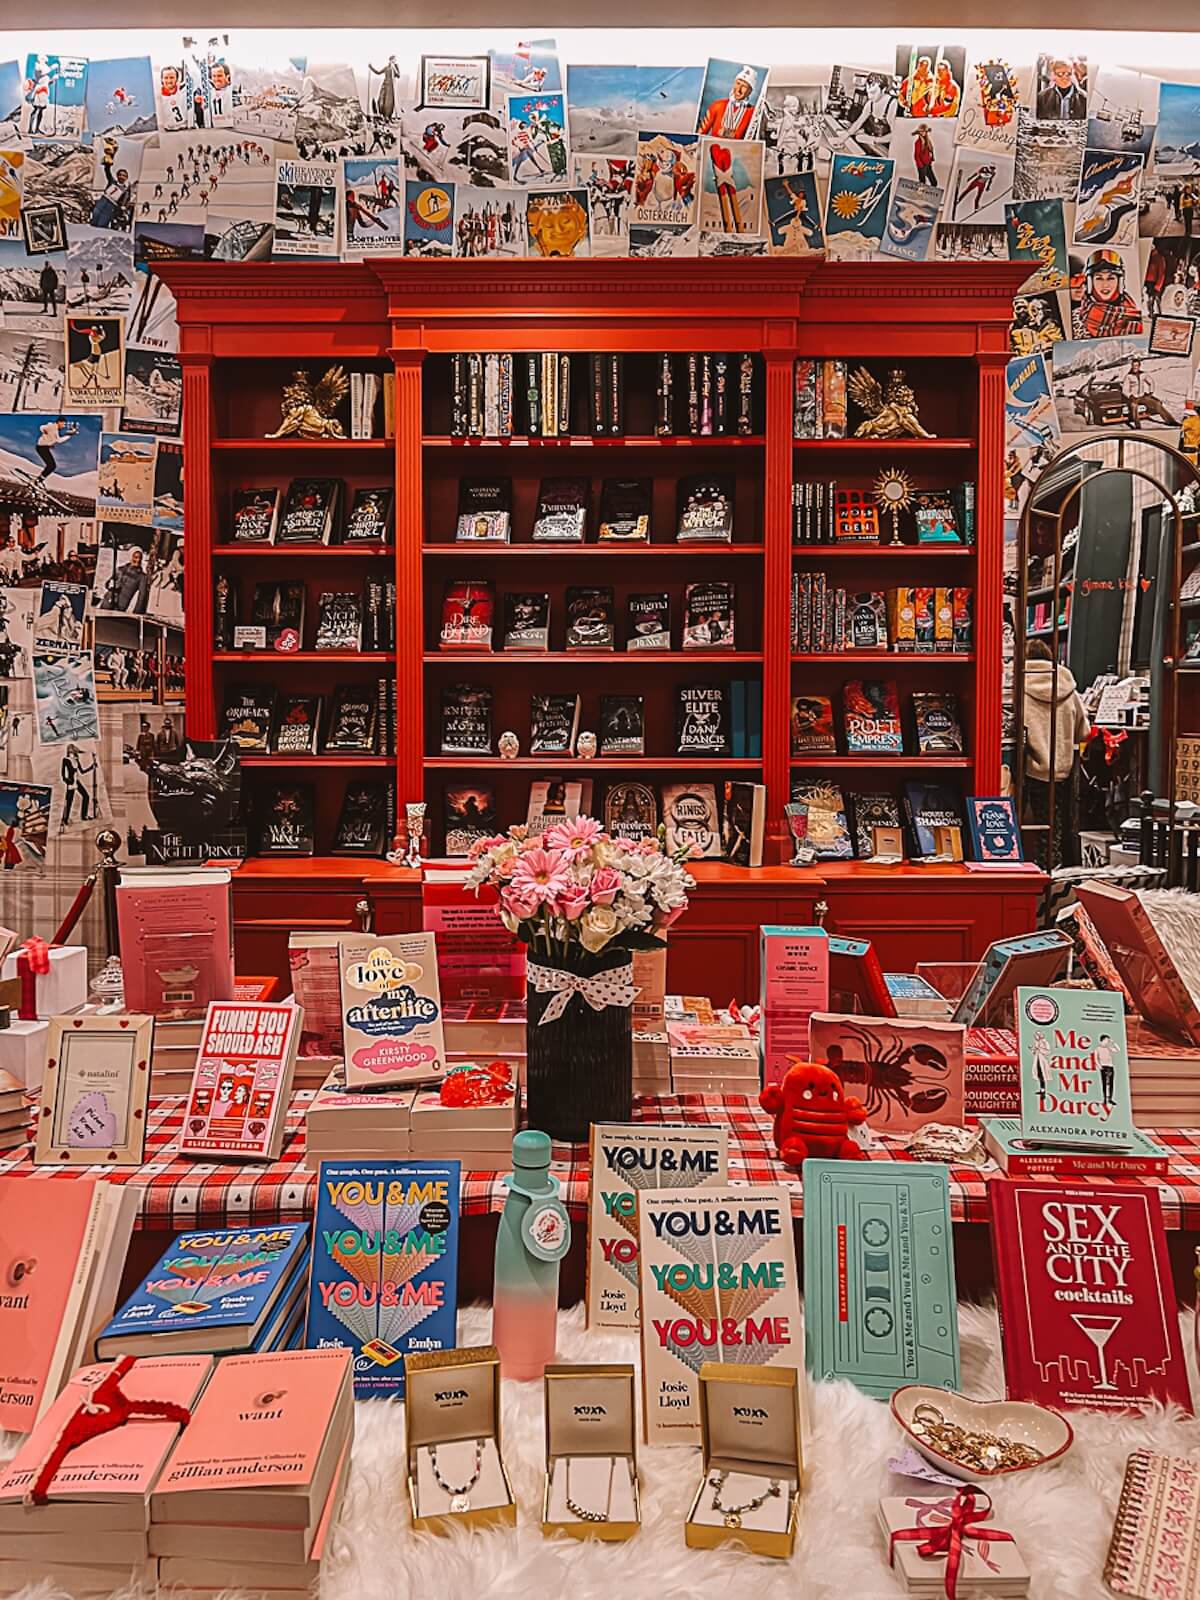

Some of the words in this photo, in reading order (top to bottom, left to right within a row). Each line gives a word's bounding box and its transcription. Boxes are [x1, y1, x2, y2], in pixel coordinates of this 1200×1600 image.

[630, 601, 668, 613] Enigma
[681, 689, 722, 701] SILVER
[685, 702, 719, 712] ELITE
[850, 719, 897, 735] POET
[681, 735, 725, 744] FRANCIS
[850, 734, 900, 744] EMPRESS
[677, 804, 706, 817] RINGS
[160, 833, 182, 847] THE
[152, 844, 193, 861] NIGHT
[199, 843, 245, 857] PRINCE
[372, 957, 391, 967] the
[356, 966, 404, 983] love
[379, 981, 391, 990] of
[386, 988, 409, 1000] my
[348, 1001, 435, 1023] afterlife
[212, 1009, 257, 1035] FUNNY
[258, 1010, 288, 1035] YOU
[207, 1032, 253, 1054] SHOULD
[1054, 1029, 1092, 1050] Me
[363, 1052, 427, 1066] GREENWOOD
[379, 1046, 410, 1056] KIRSTY
[1050, 1053, 1097, 1071] and
[87, 1070, 119, 1078] natalini
[1058, 1073, 1093, 1094] Mr
[1037, 1094, 1117, 1122] Darcy
[1029, 1125, 1087, 1136] ALEXANDRA
[1090, 1130, 1128, 1139] POTTER
[1087, 1160, 1105, 1169] and
[1120, 1161, 1147, 1171] Darcy
[326, 1181, 384, 1206] YOU
[408, 1181, 449, 1206] ME
[898, 1191, 907, 1207] Me
[650, 1211, 710, 1237] YOU
[738, 1209, 781, 1234] ME
[900, 1216, 908, 1234] You
[1041, 1201, 1129, 1246] SEX
[322, 1231, 380, 1255] YOU
[406, 1231, 447, 1254] ME
[899, 1236, 909, 1254] and
[1045, 1242, 1088, 1256] AND
[1092, 1244, 1131, 1258] THE
[901, 1255, 910, 1270] Me
[1045, 1254, 1134, 1287] CITY
[650, 1264, 713, 1291] YOU
[741, 1262, 785, 1289] ME
[319, 1281, 377, 1307] YOU
[402, 1281, 445, 1307] ME
[601, 1289, 626, 1300] Josie
[902, 1281, 911, 1299] You
[1054, 1287, 1134, 1305] cocktails
[600, 1302, 627, 1313] Lloyd
[902, 1302, 912, 1321] and
[652, 1318, 718, 1347] YOU
[745, 1317, 791, 1345] ME
[904, 1322, 913, 1337] Me
[408, 1337, 442, 1350] Emlyn
[905, 1349, 915, 1368] You
[659, 1381, 688, 1393] Josie
[659, 1396, 690, 1410] Lloyd
[238, 1408, 284, 1421] want
[61, 1470, 140, 1482] anderson
[168, 1465, 223, 1483] gillian
[226, 1462, 304, 1475] anderson
